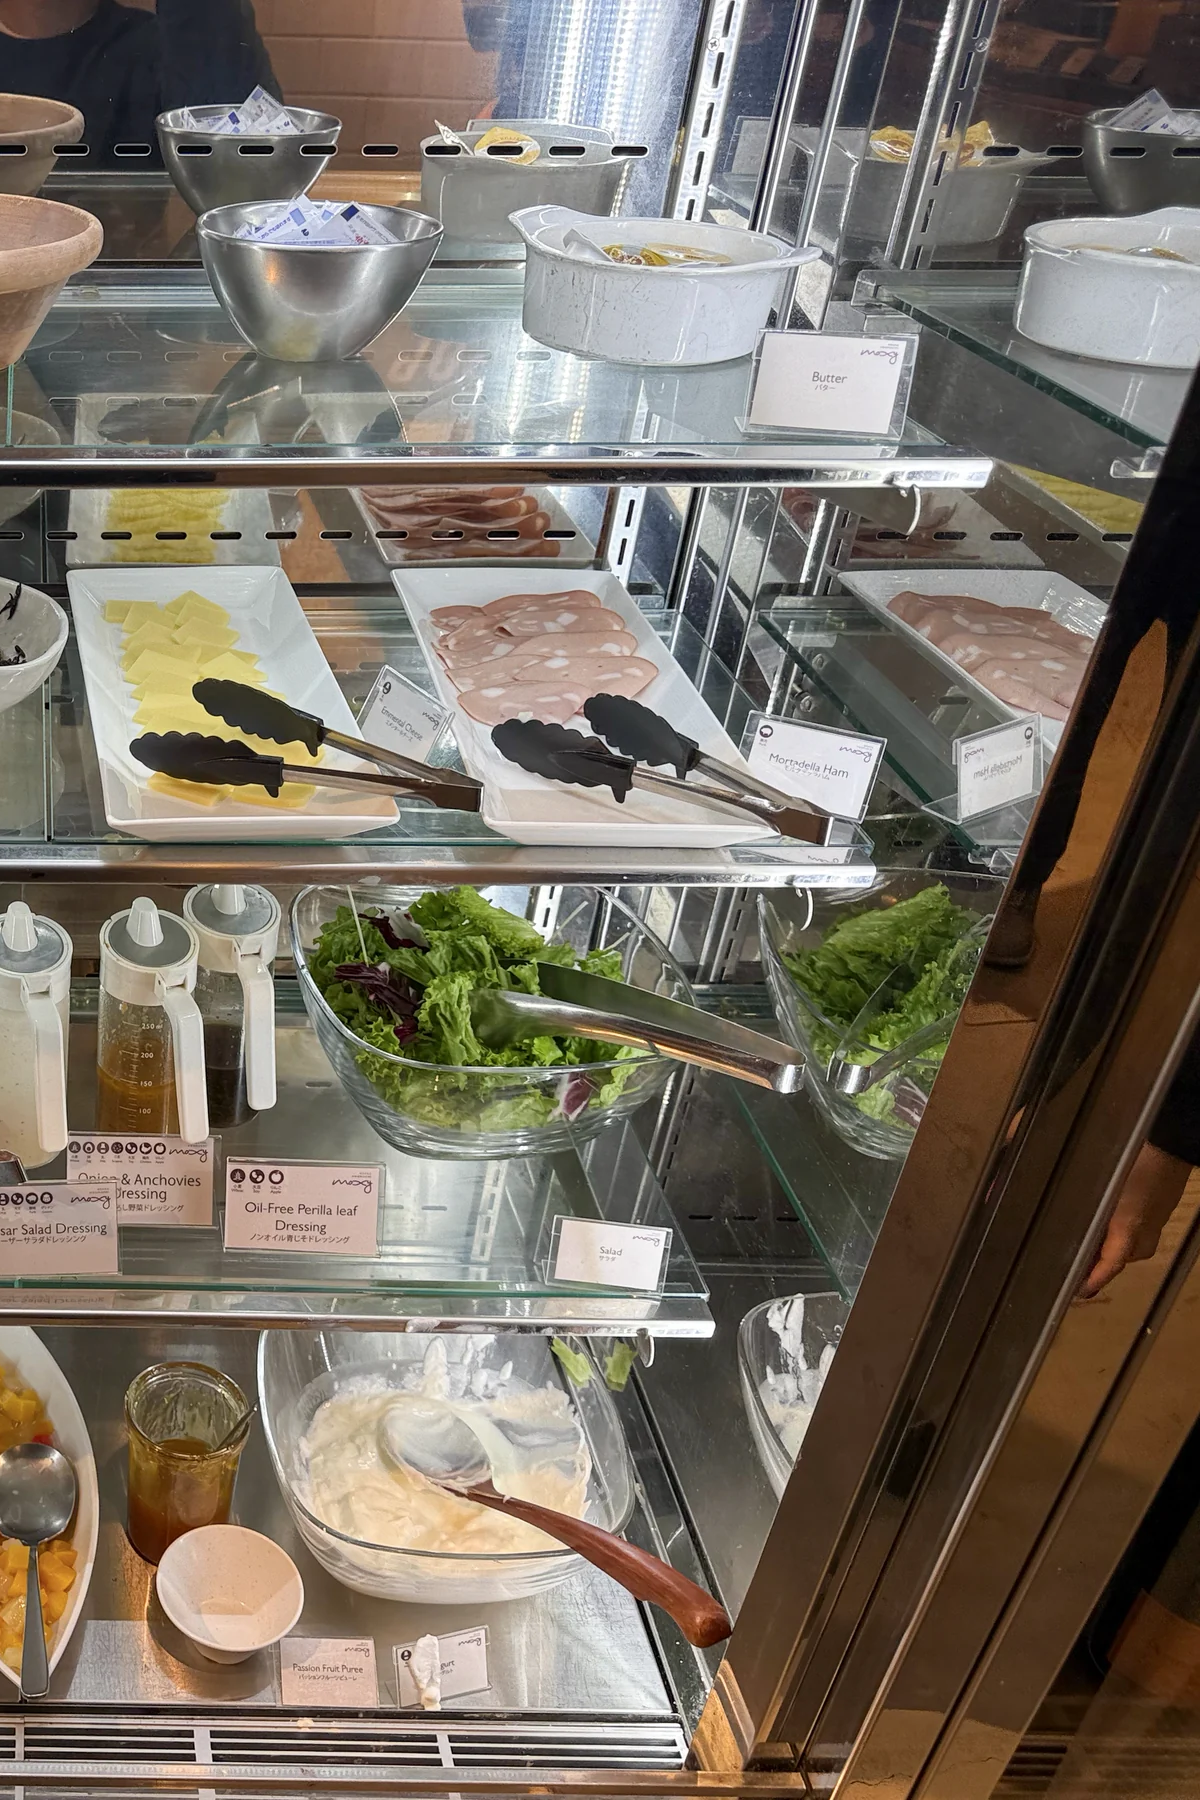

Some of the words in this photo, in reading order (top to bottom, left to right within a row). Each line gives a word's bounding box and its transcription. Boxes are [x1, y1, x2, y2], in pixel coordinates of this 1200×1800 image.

[812, 371, 848, 384] Butter
[768, 753, 820, 772] Mortadella
[823, 763, 849, 779] Ham
[121, 1173, 131, 1186] &
[134, 1173, 201, 1187] Anchovies
[245, 1202, 294, 1215] Oil-Free
[298, 1204, 332, 1216] Perilla
[336, 1205, 358, 1216] leaf
[21, 1224, 52, 1236] Salad
[56, 1223, 107, 1236] Dressing
[275, 1219, 327, 1235] Dressing
[250, 1234, 350, 1244] ノンオイル青じそドレッシング
[600, 1246, 623, 1256] Salad
[292, 1663, 320, 1672] Passion
[322, 1664, 340, 1673] Fruit
[341, 1664, 363, 1673] Puree
